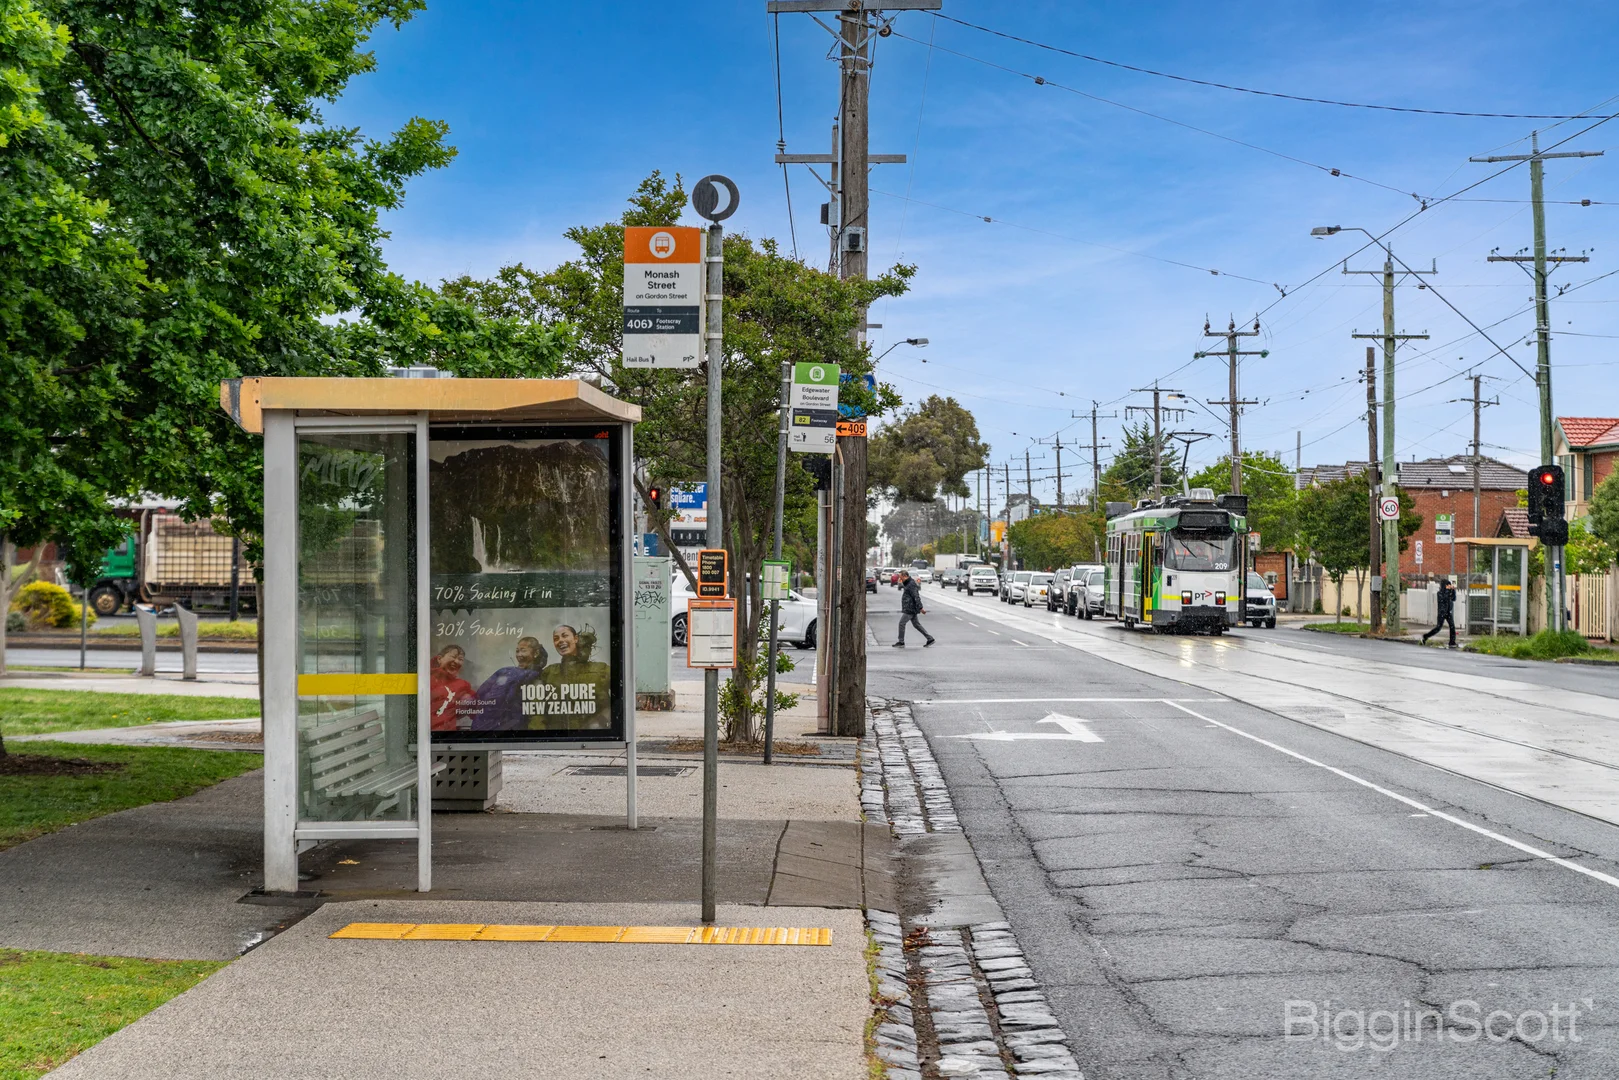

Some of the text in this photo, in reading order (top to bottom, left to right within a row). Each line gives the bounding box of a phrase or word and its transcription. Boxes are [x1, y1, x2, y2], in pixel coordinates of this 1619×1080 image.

[644, 270, 680, 279] Monash
[647, 281, 677, 289] Street
[627, 319, 648, 329] 406
[801, 386, 830, 394] Edgewater
[848, 423, 865, 434] 409
[824, 436, 835, 444] 56
[1384, 504, 1396, 512] 60
[1214, 562, 1228, 570] 209
[434, 582, 552, 603] 70% Soaking it in
[436, 619, 524, 638] 30% Soaking
[520, 683, 596, 701] 100% PURE
[521, 701, 596, 715] NEW ZEALAND
